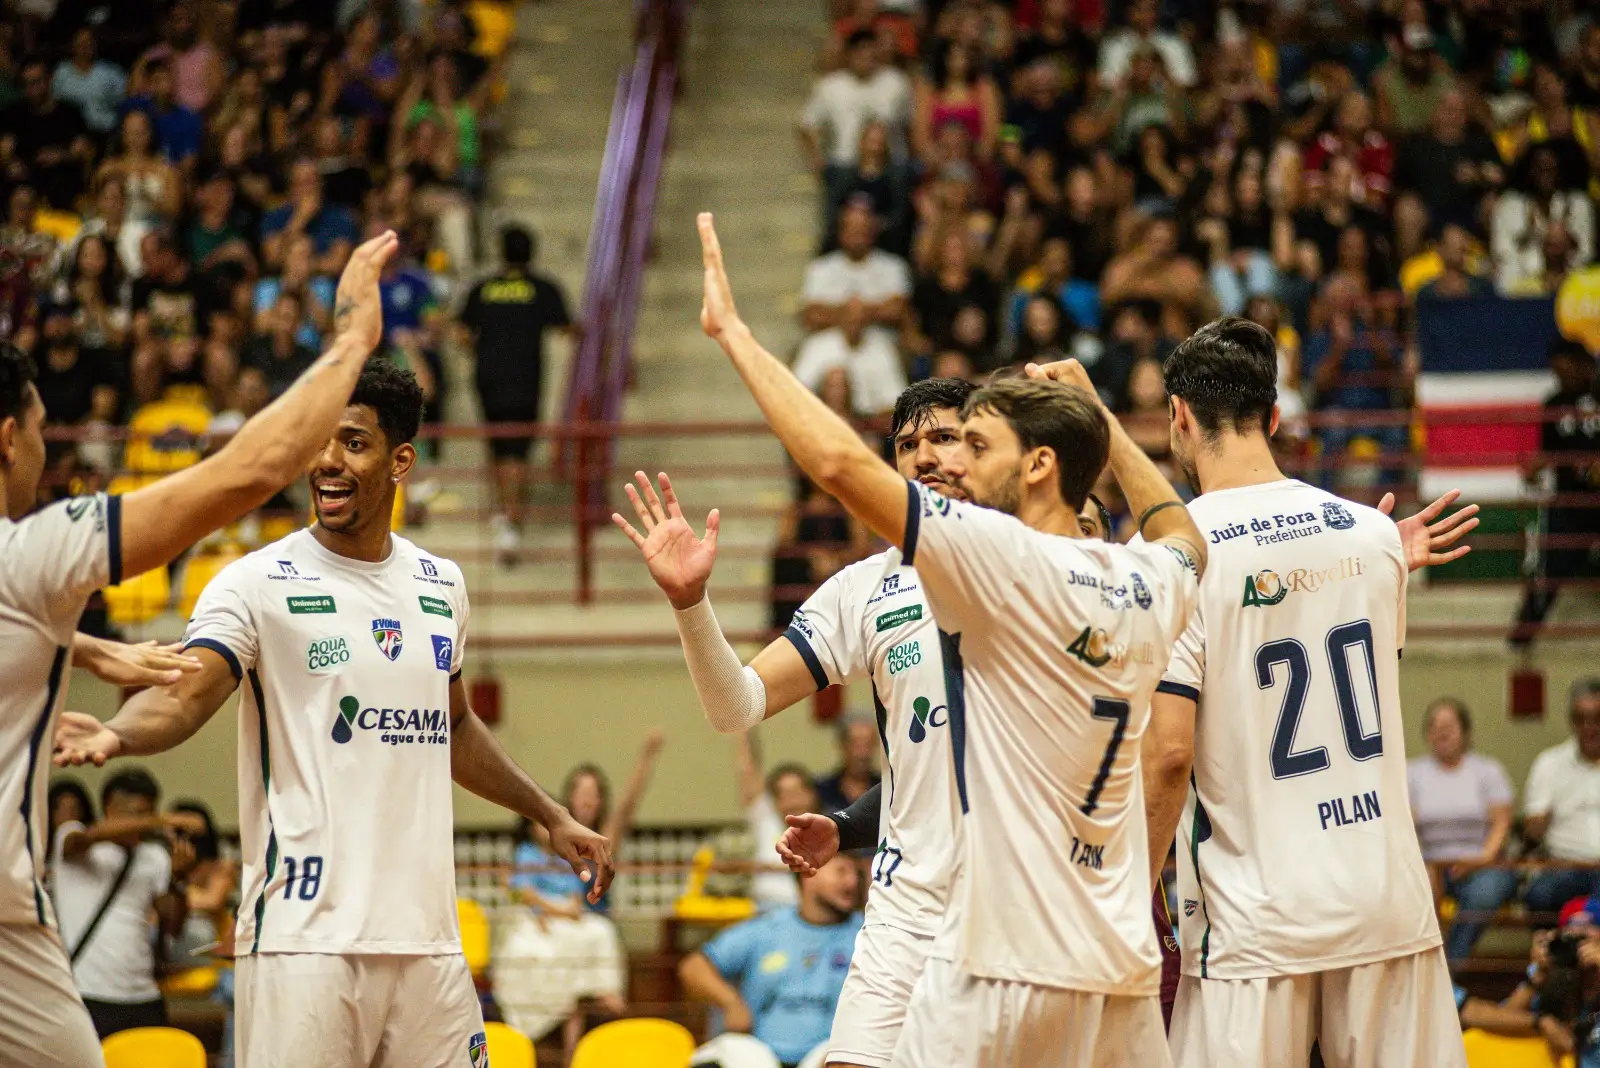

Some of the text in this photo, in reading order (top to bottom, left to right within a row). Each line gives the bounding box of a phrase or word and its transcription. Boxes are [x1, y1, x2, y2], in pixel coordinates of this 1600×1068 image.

[1210, 511, 1317, 544] Juiz de Fora
[1254, 524, 1322, 546] Prefeitura
[1067, 569, 1098, 588] Juiz
[1286, 555, 1364, 593] Rivelli
[898, 584, 917, 594] Hotel
[291, 599, 321, 608] Unimed
[880, 610, 909, 625] Unimed
[308, 637, 347, 657] AQUA
[887, 640, 919, 662] AQUA
[308, 649, 350, 670] COCO
[889, 652, 921, 675] COCO
[1253, 618, 1383, 781] 20
[358, 707, 448, 732] CESAMA
[381, 731, 414, 746] água
[417, 732, 425, 744] é
[1079, 694, 1131, 817] 7
[1317, 790, 1382, 830] PILAN
[283, 855, 324, 901] 18
